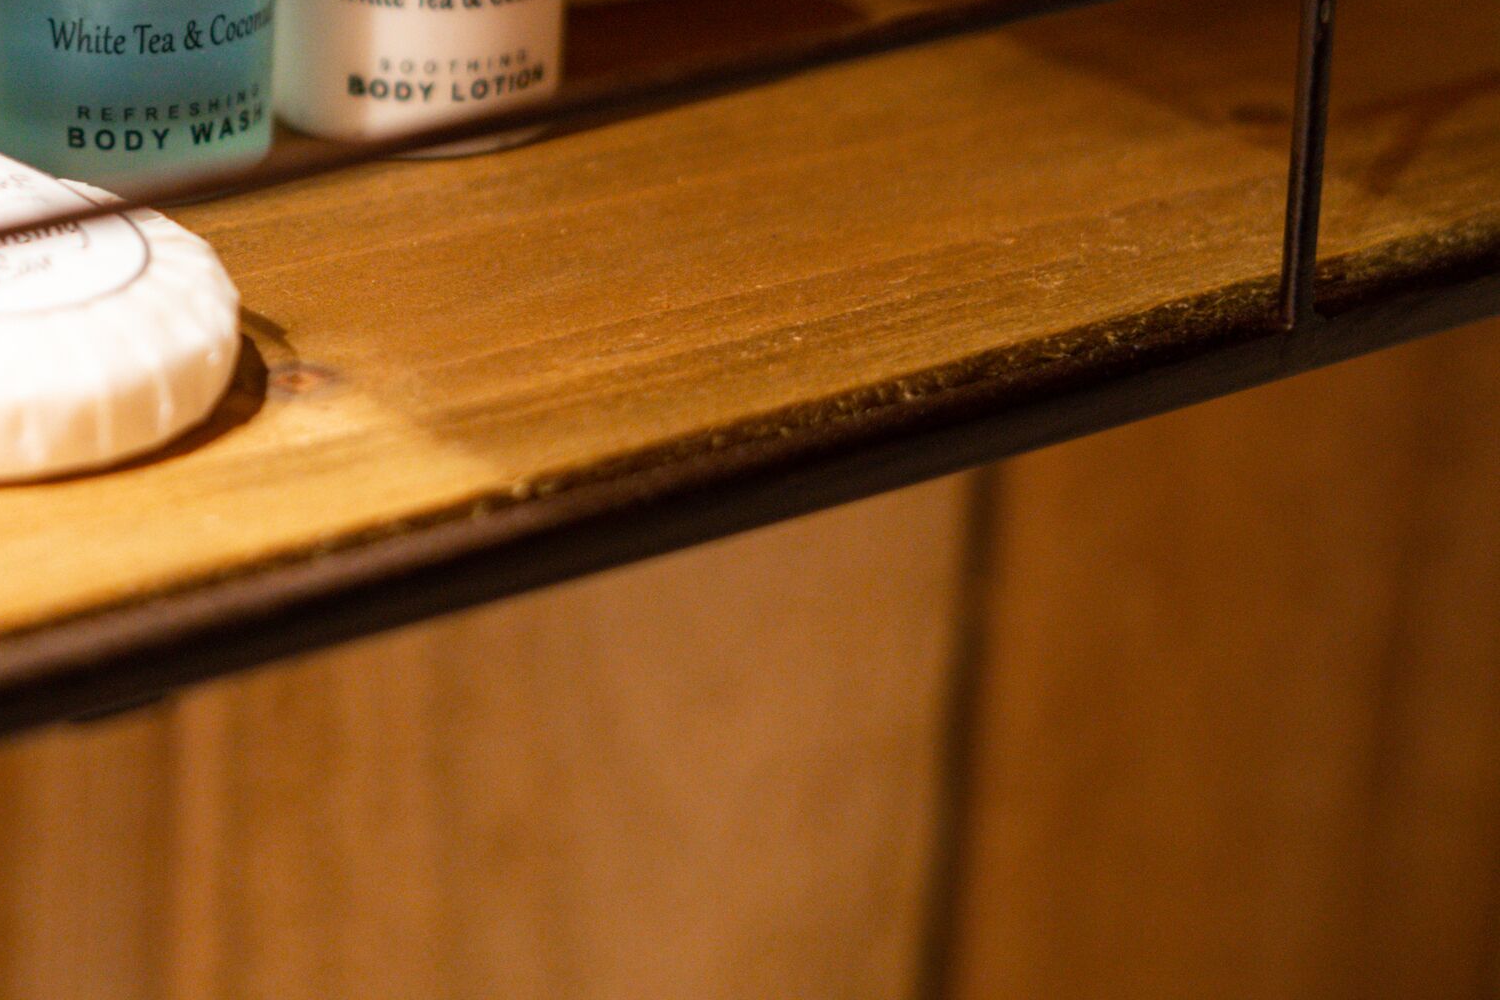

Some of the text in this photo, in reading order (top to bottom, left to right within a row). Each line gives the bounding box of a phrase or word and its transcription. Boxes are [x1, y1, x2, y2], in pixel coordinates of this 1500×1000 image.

[48, 18, 126, 55] White
[134, 23, 176, 55] Tea
[184, 19, 203, 50] &
[348, 62, 543, 101] BODY LOTION
[67, 102, 263, 151] BODY WASH
